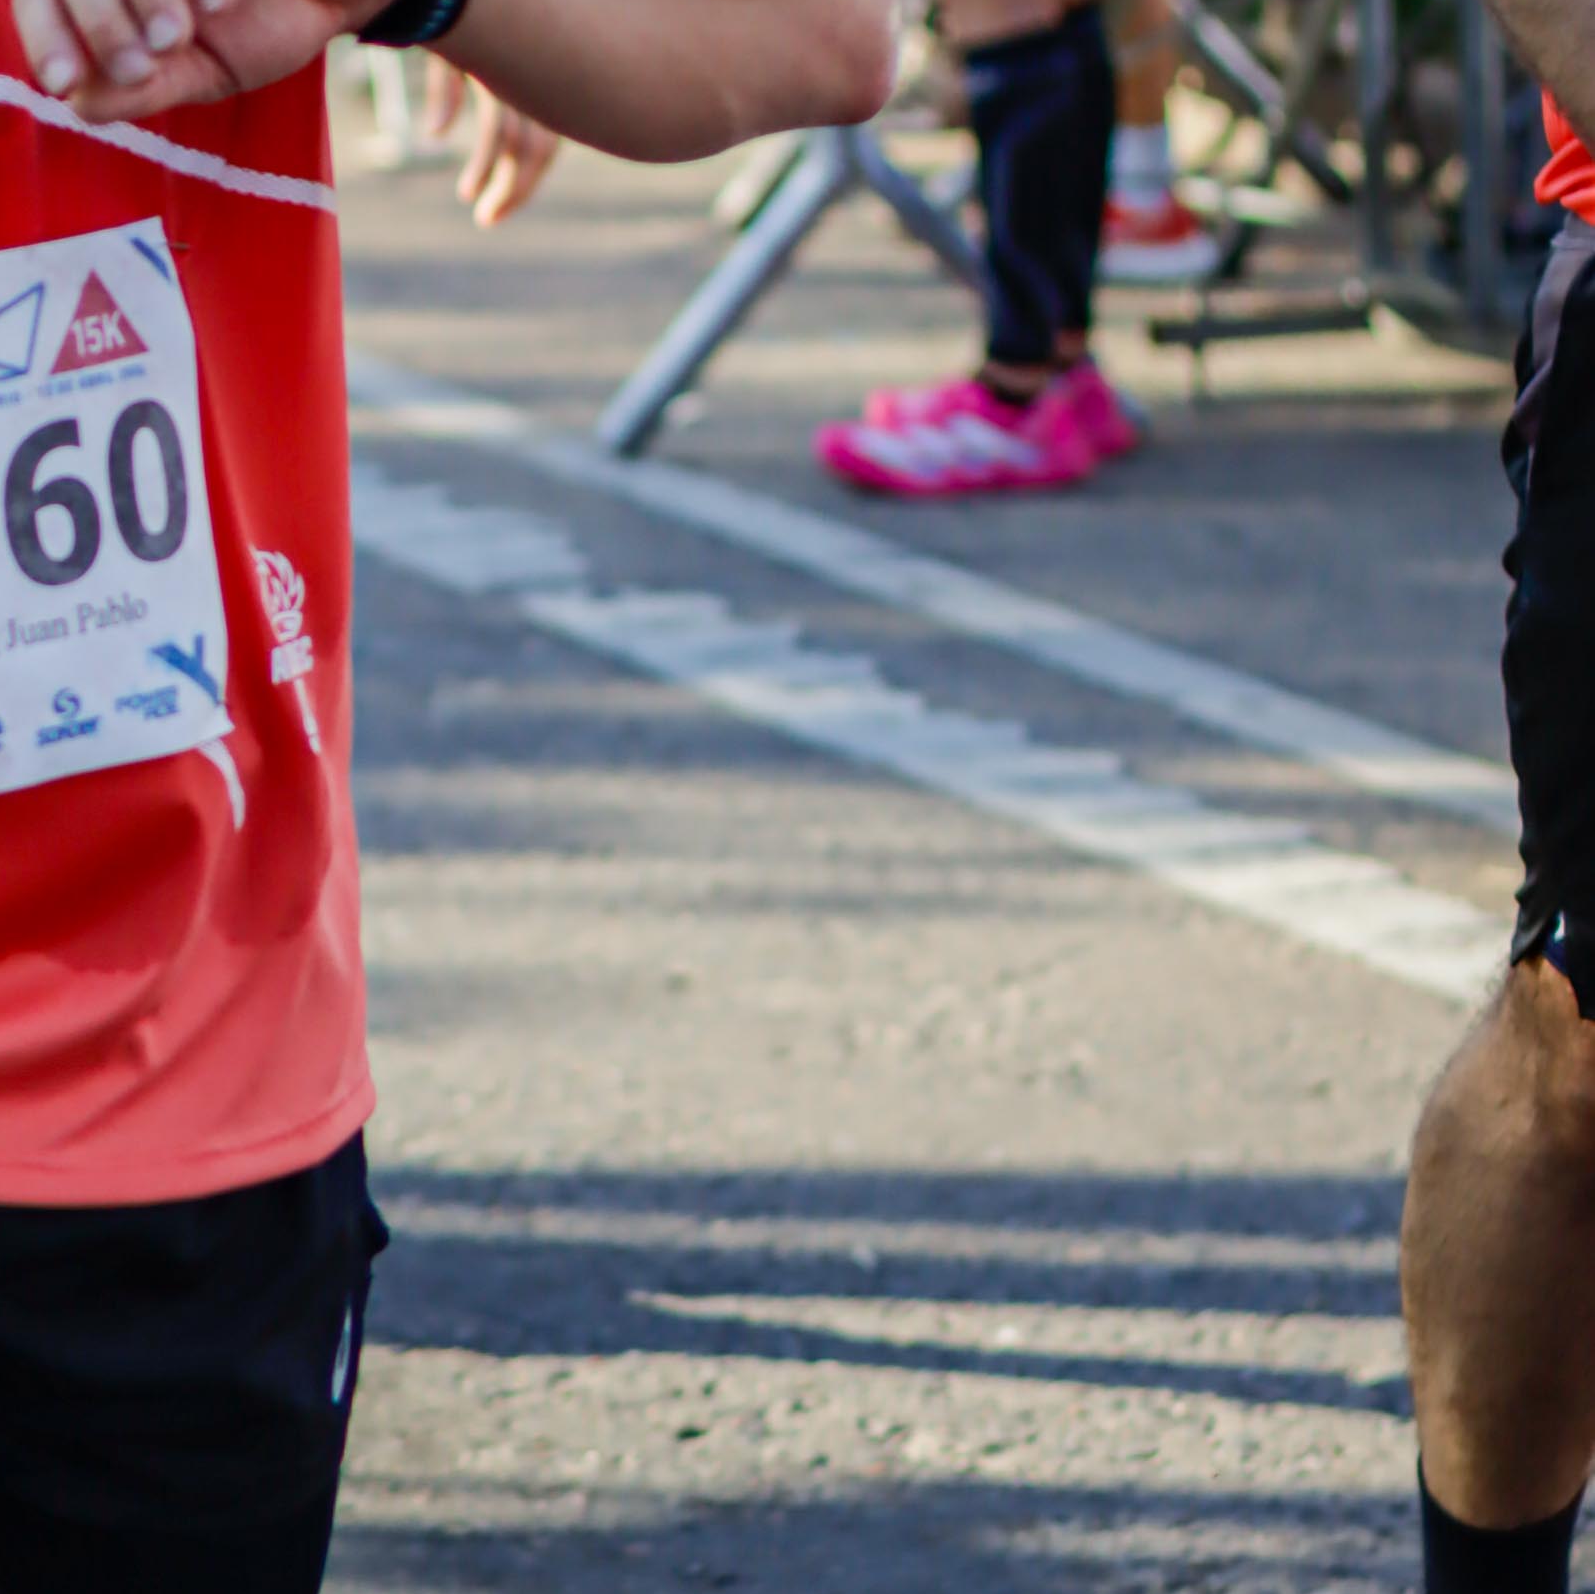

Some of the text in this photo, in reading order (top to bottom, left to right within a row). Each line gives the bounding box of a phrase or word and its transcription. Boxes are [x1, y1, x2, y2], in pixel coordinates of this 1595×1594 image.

[69, 309, 131, 357] 15K
[6, 614, 70, 651] Juan
[76, 591, 149, 634] Pablo
